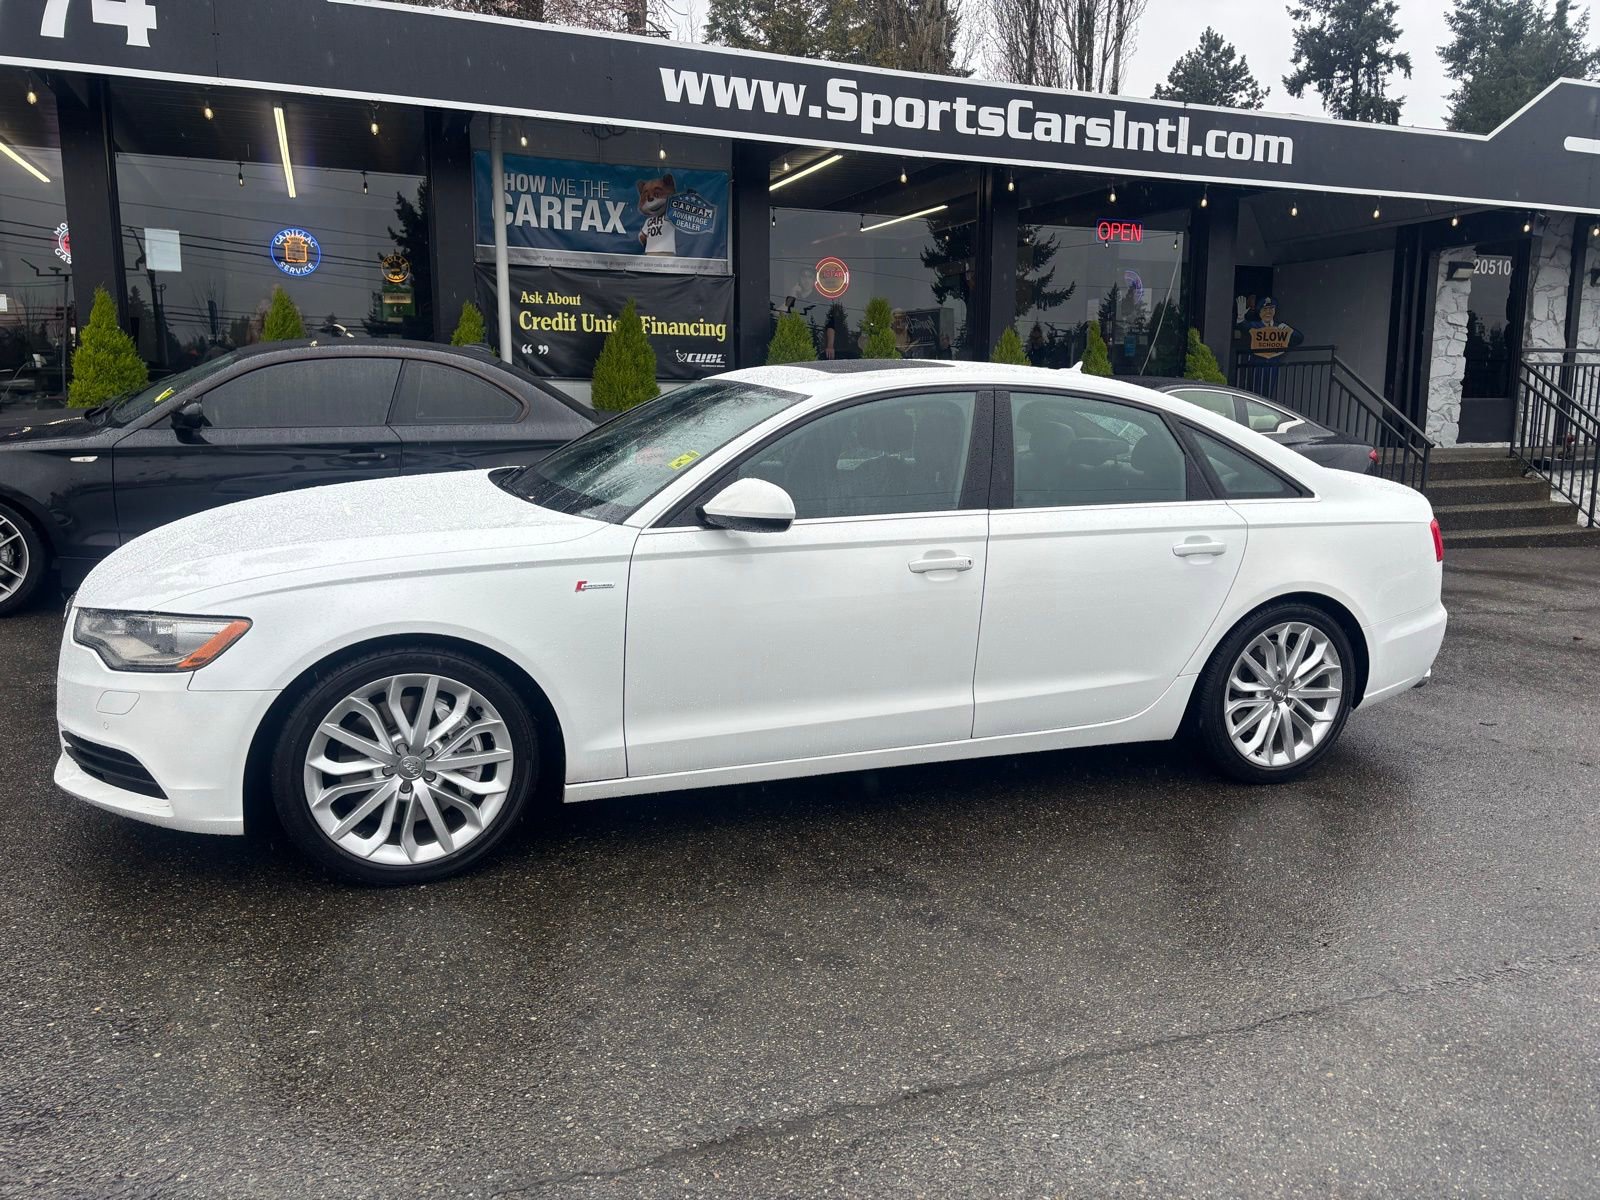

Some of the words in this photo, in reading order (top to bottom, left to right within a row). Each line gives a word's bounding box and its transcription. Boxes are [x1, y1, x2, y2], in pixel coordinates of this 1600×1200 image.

[659, 67, 1294, 165] www.SportsCarsIntl.com
[504, 173, 546, 193] HOW
[552, 177, 576, 196] ME
[580, 179, 610, 199] THE
[672, 200, 713, 219] CARFAX
[672, 210, 708, 226] ADVANTAGE
[647, 225, 663, 237] FOX
[676, 220, 701, 232] DEALER
[1097, 221, 1142, 241] OPEN
[274, 229, 315, 247] CADILLAC
[279, 261, 315, 274] SERVICE
[1473, 258, 1512, 276] 20510
[520, 291, 544, 304] Ask
[546, 292, 581, 306] About
[519, 310, 577, 332] Credit
[581, 313, 620, 333] Uni
[640, 315, 727, 342] Financing
[1256, 331, 1288, 342] SLOW
